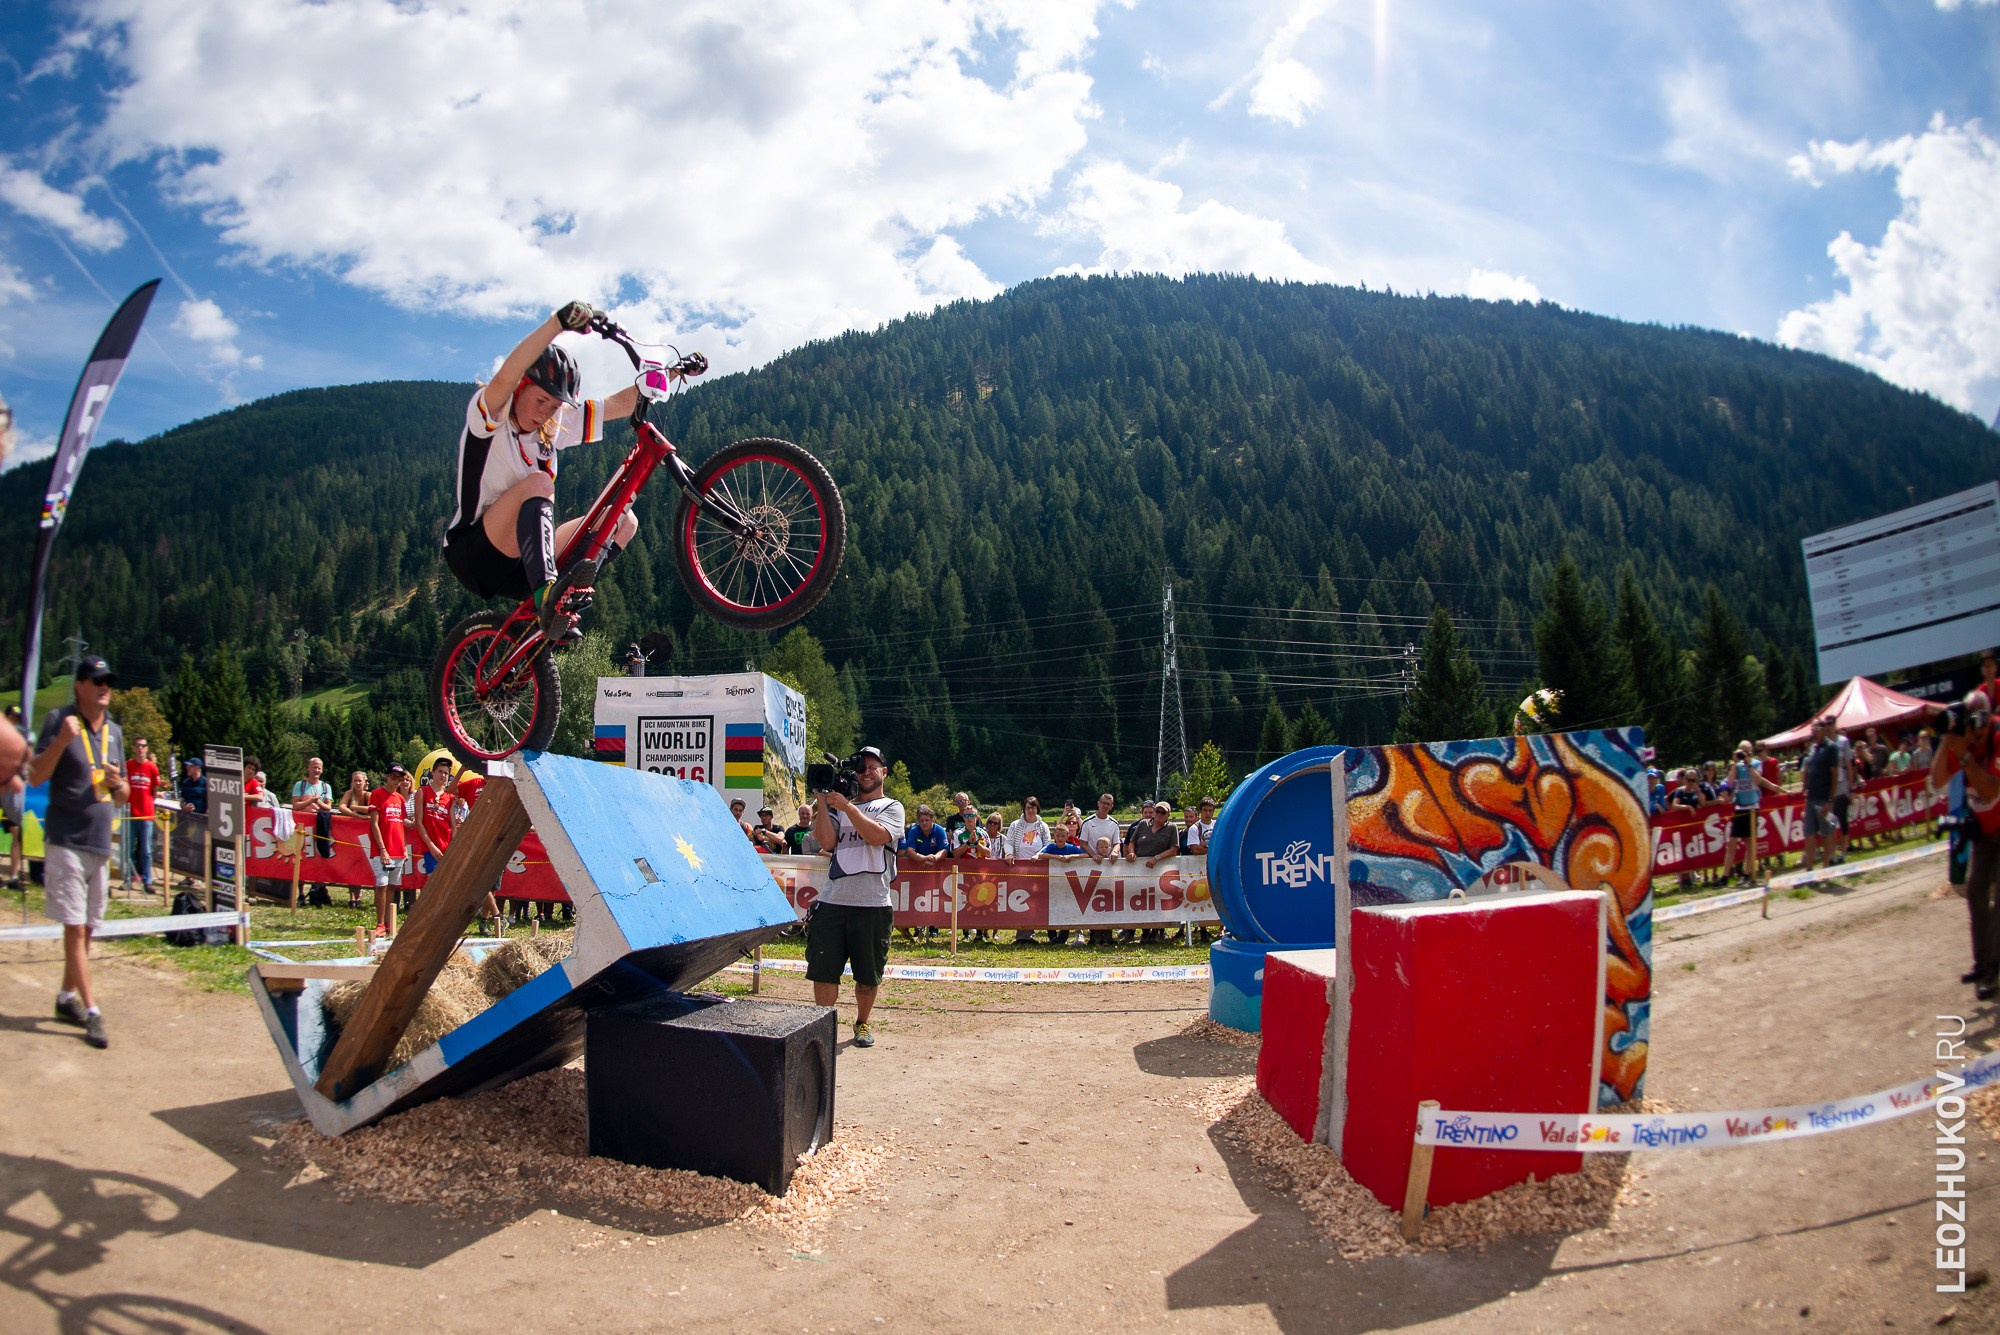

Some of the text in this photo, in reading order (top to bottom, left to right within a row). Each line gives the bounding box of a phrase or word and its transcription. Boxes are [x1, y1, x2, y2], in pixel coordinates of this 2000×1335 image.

[656, 373, 662, 389] 2
[725, 687, 755, 696] TRENTINO
[785, 694, 805, 723] BIKE
[644, 731, 706, 749] WORLD
[789, 722, 805, 748] FUN
[646, 754, 705, 762] CHAMPIONSHIPS
[209, 777, 241, 795] START
[1879, 785, 1914, 823] Val
[219, 802, 233, 837] 5
[1769, 805, 1806, 848] Va
[1685, 832, 1707, 859] di
[1255, 851, 1336, 888] TRENT
[913, 888, 940, 913] di
[942, 872, 1031, 914] Sole
[1064, 869, 1212, 916] Val di So
[1889, 1092, 1913, 1109] Val
[1725, 1115, 1800, 1138] Val di Sole
[1807, 1103, 1877, 1129] TRENTINO
[1434, 1119, 1520, 1145] TRENTINO
[1539, 1120, 1622, 1144] Val di Sole
[1631, 1122, 1708, 1147] TRENTINO
